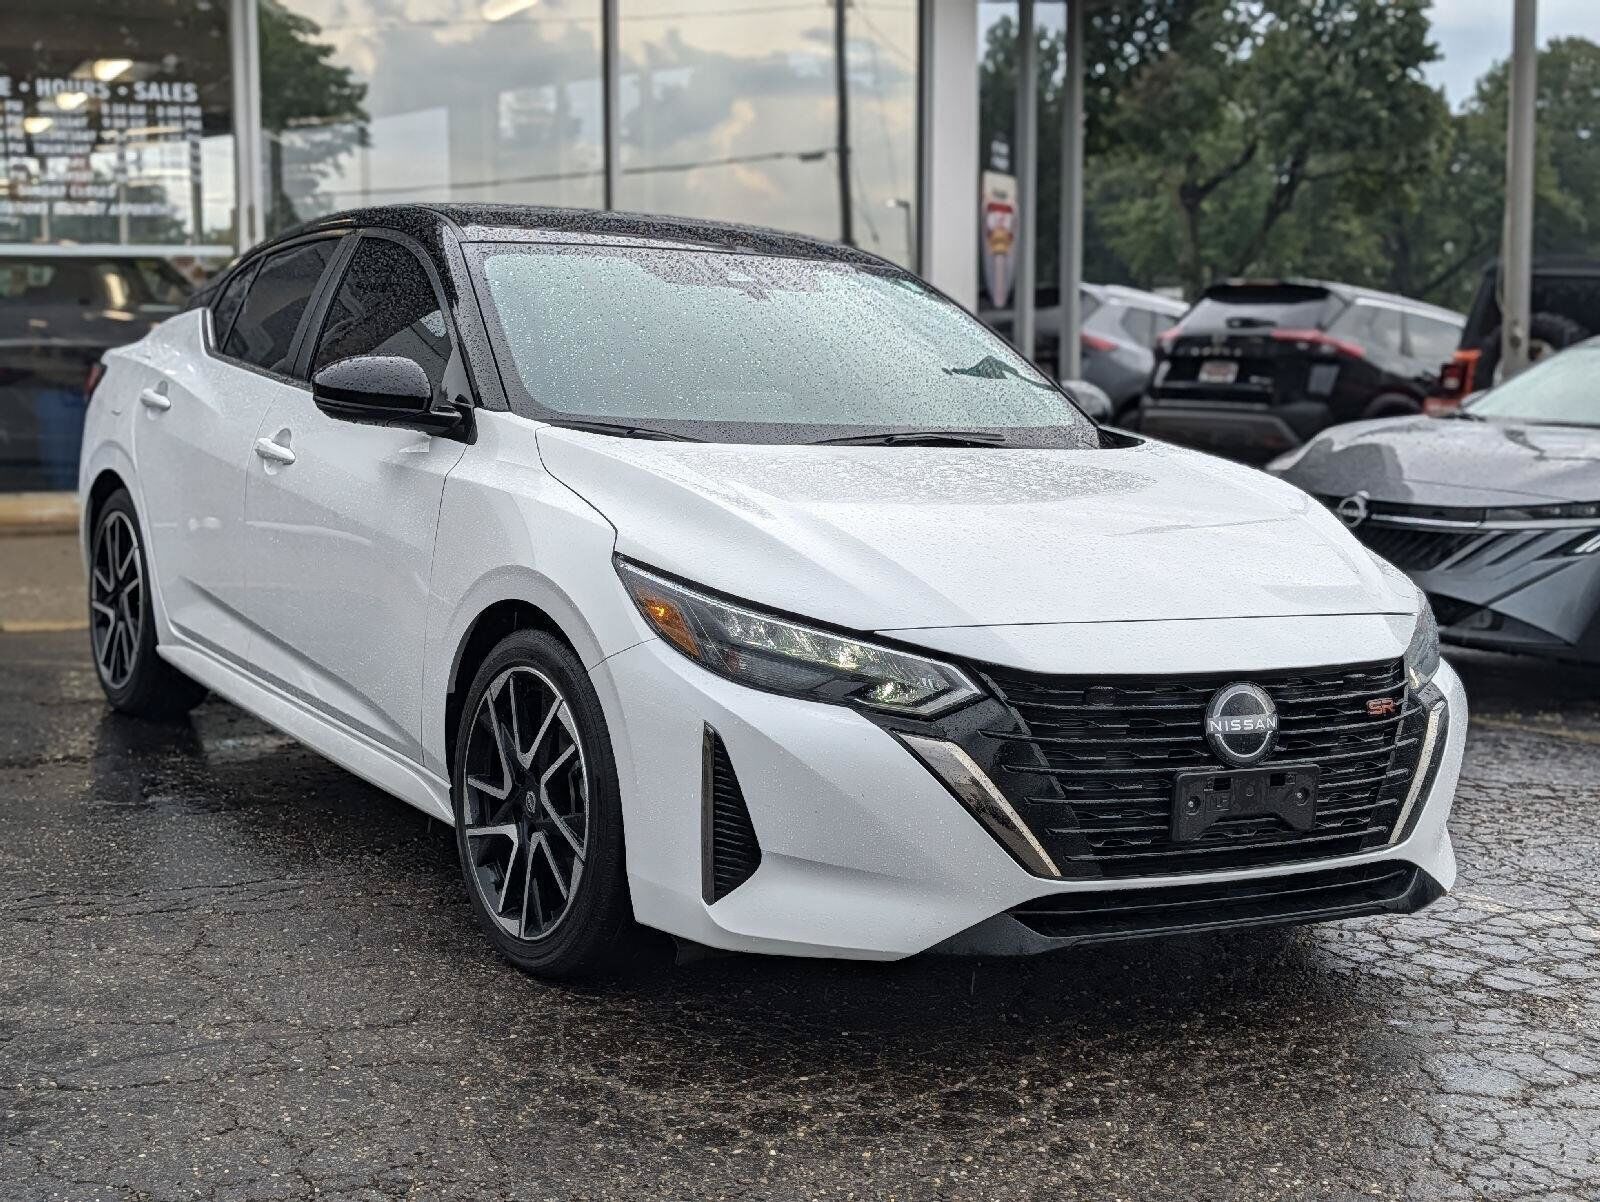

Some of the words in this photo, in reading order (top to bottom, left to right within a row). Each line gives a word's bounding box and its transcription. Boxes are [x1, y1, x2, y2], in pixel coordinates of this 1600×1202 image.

[35, 78, 111, 99] HOURS
[133, 81, 199, 102] SALES
[1366, 698, 1396, 715] SR
[1209, 716, 1277, 732] NISSAN
